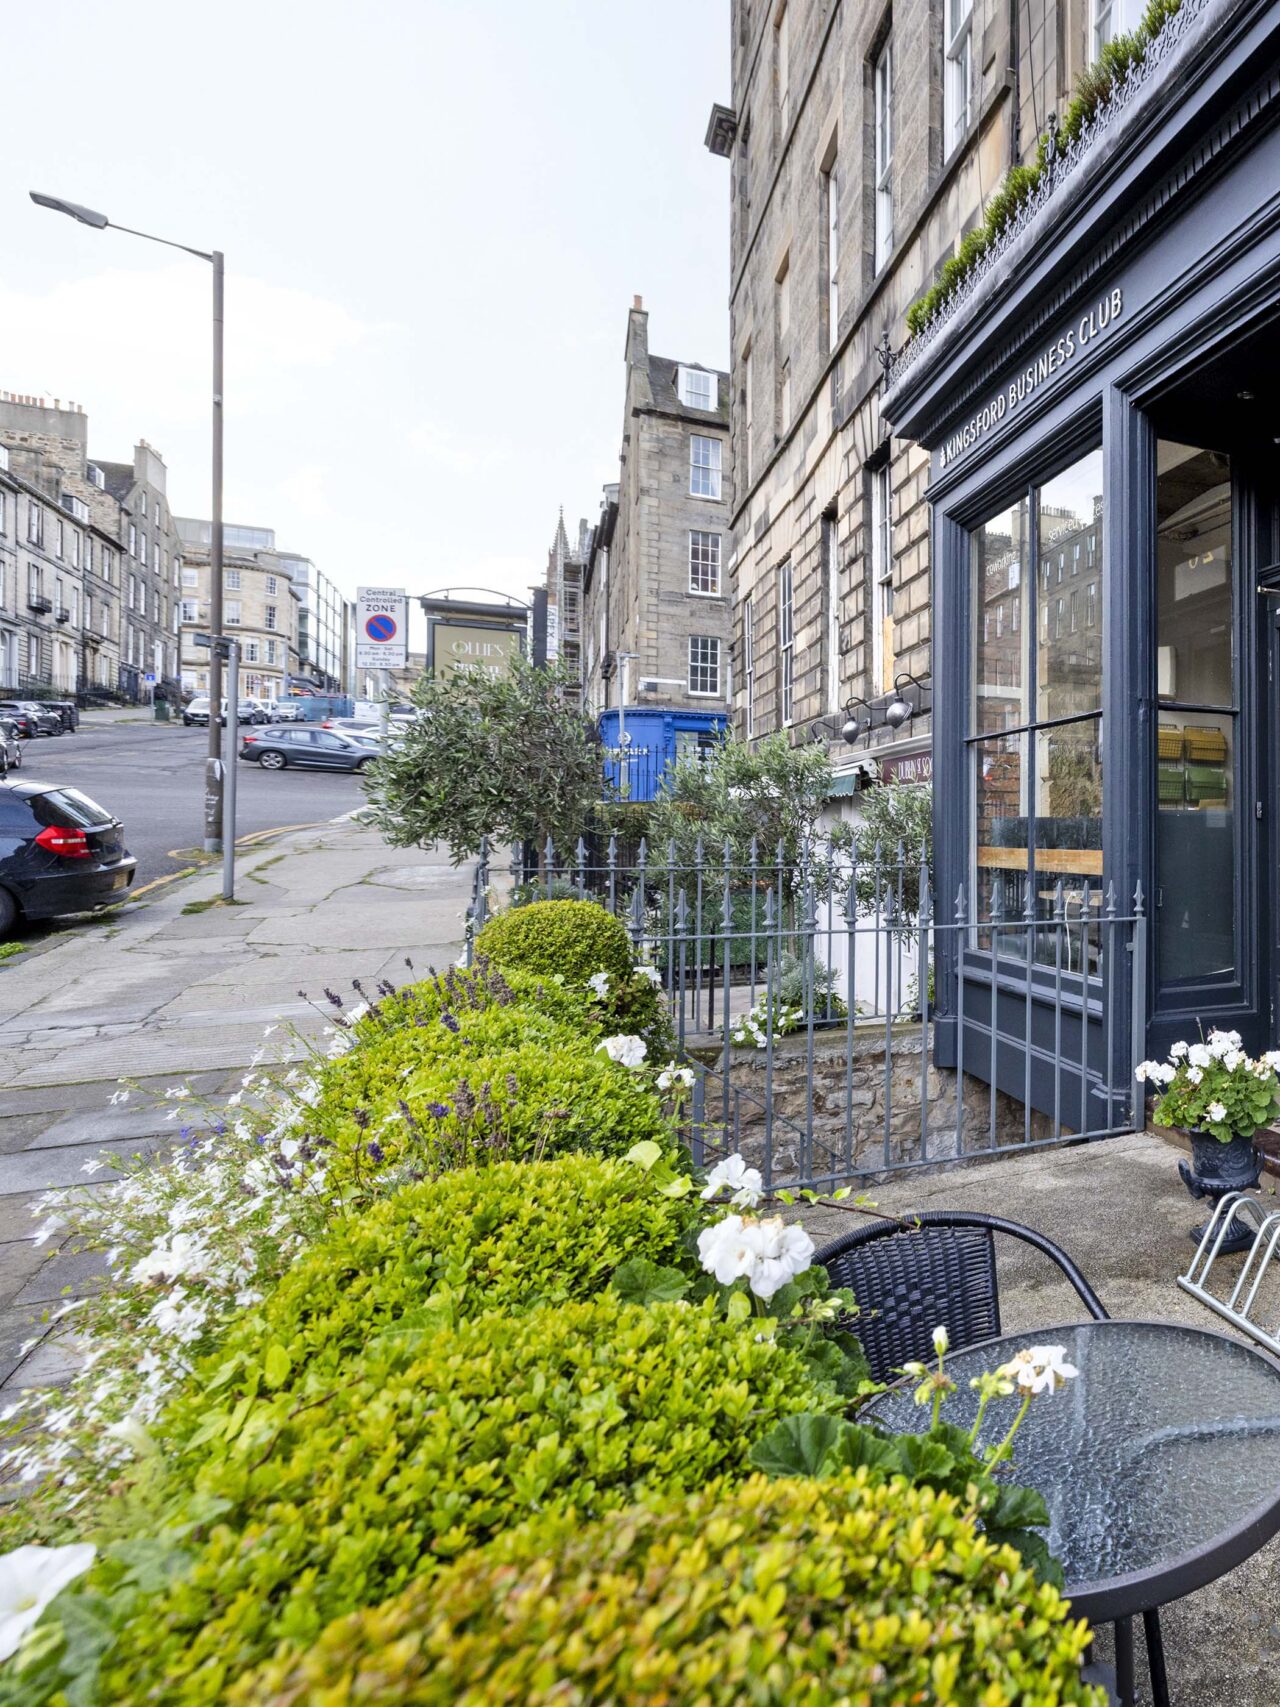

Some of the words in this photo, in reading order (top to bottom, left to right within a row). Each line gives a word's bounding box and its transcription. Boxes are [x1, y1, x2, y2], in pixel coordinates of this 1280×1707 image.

[946, 394, 1007, 463] KINGSFORD
[1008, 330, 1076, 409] BUSINESS
[1079, 288, 1122, 345] CLUB
[366, 589, 397, 597] Central
[360, 596, 403, 604] Controlled
[366, 604, 397, 613] ZONE
